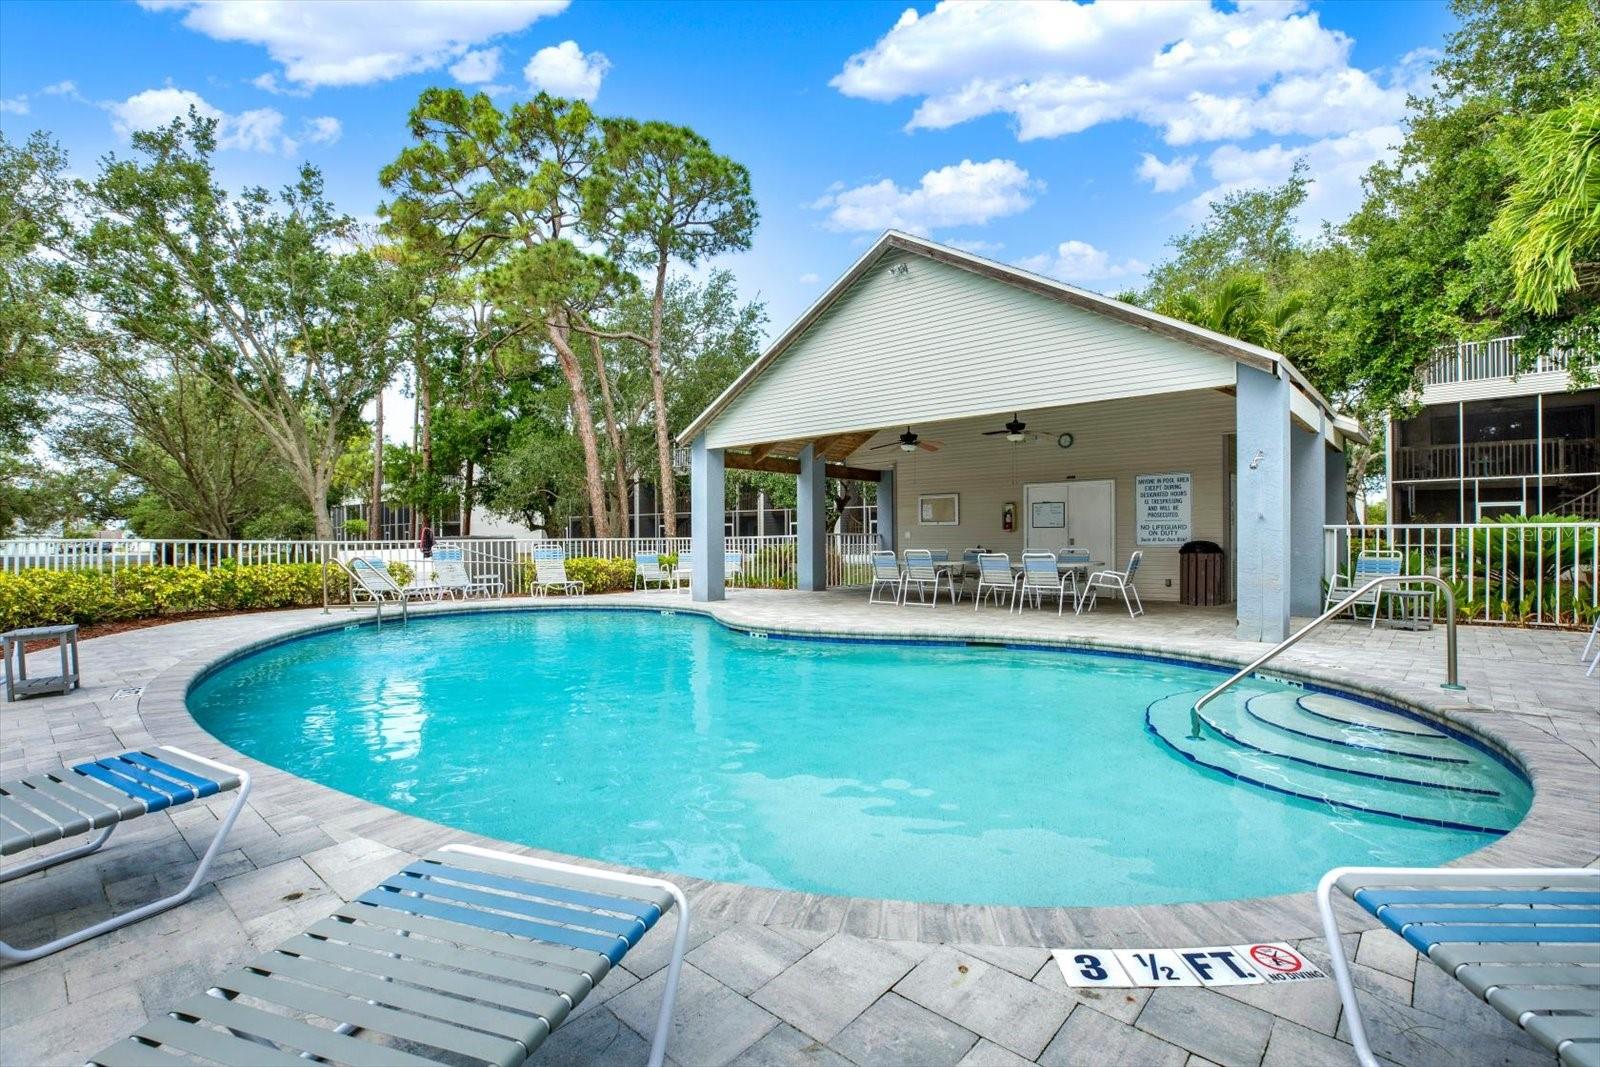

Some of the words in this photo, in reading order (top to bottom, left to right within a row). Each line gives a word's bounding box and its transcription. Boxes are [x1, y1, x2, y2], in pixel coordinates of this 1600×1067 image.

[1074, 954, 1109, 981] 3
[1181, 951, 1257, 981] FT.
[1268, 973, 1287, 982] NO
[1288, 970, 1326, 981] DIVING
